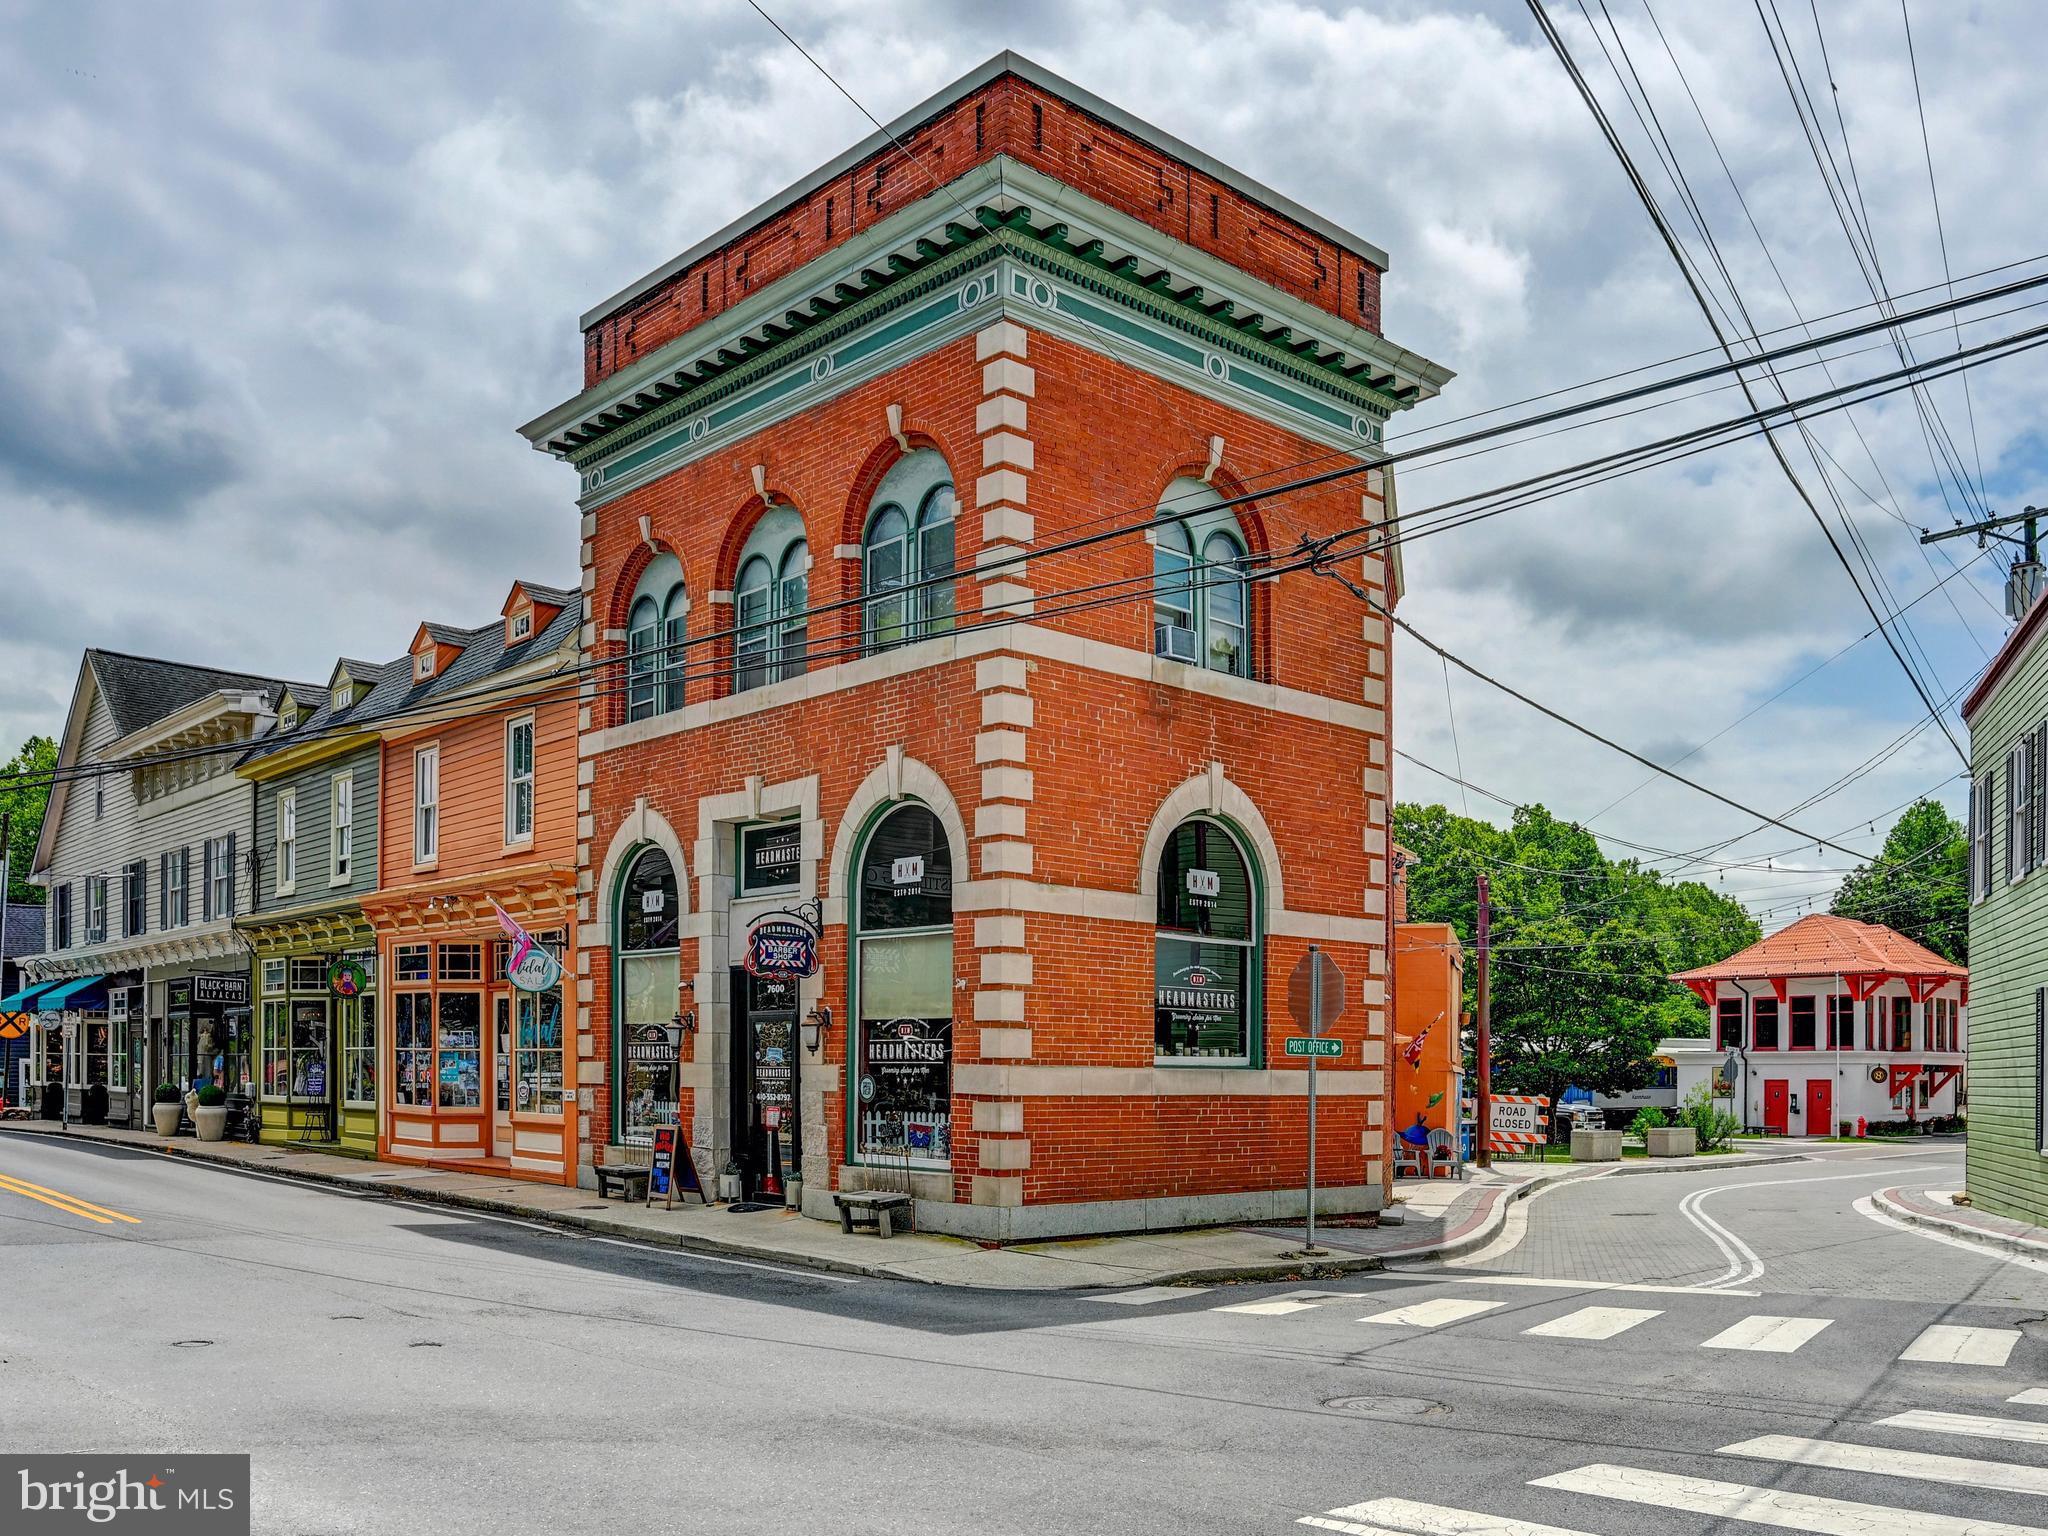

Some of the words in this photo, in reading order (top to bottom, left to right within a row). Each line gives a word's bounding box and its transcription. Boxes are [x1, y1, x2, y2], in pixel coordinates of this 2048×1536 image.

[755, 846, 800, 865] HEADMASTE
[759, 925, 807, 938] HEADMASTERS
[767, 946, 798, 954] BARBER
[200, 979, 221, 990] BLACK
[224, 981, 242, 991] BARN
[767, 984, 785, 993] 7600
[200, 990, 242, 1000] ALPACAS
[1158, 989, 1236, 1009] HEADMASTERS
[19, 1017, 26, 1026] R
[628, 1045, 676, 1060] HEADMASTER
[869, 1043, 944, 1060] HEADMASTERS
[1289, 1040, 1306, 1053] POST
[1307, 1041, 1329, 1054] OFFICE
[756, 1068, 791, 1078] HEADMASTERS
[1499, 1106, 1527, 1117] ROAD
[1492, 1118, 1531, 1130] CLOSED
